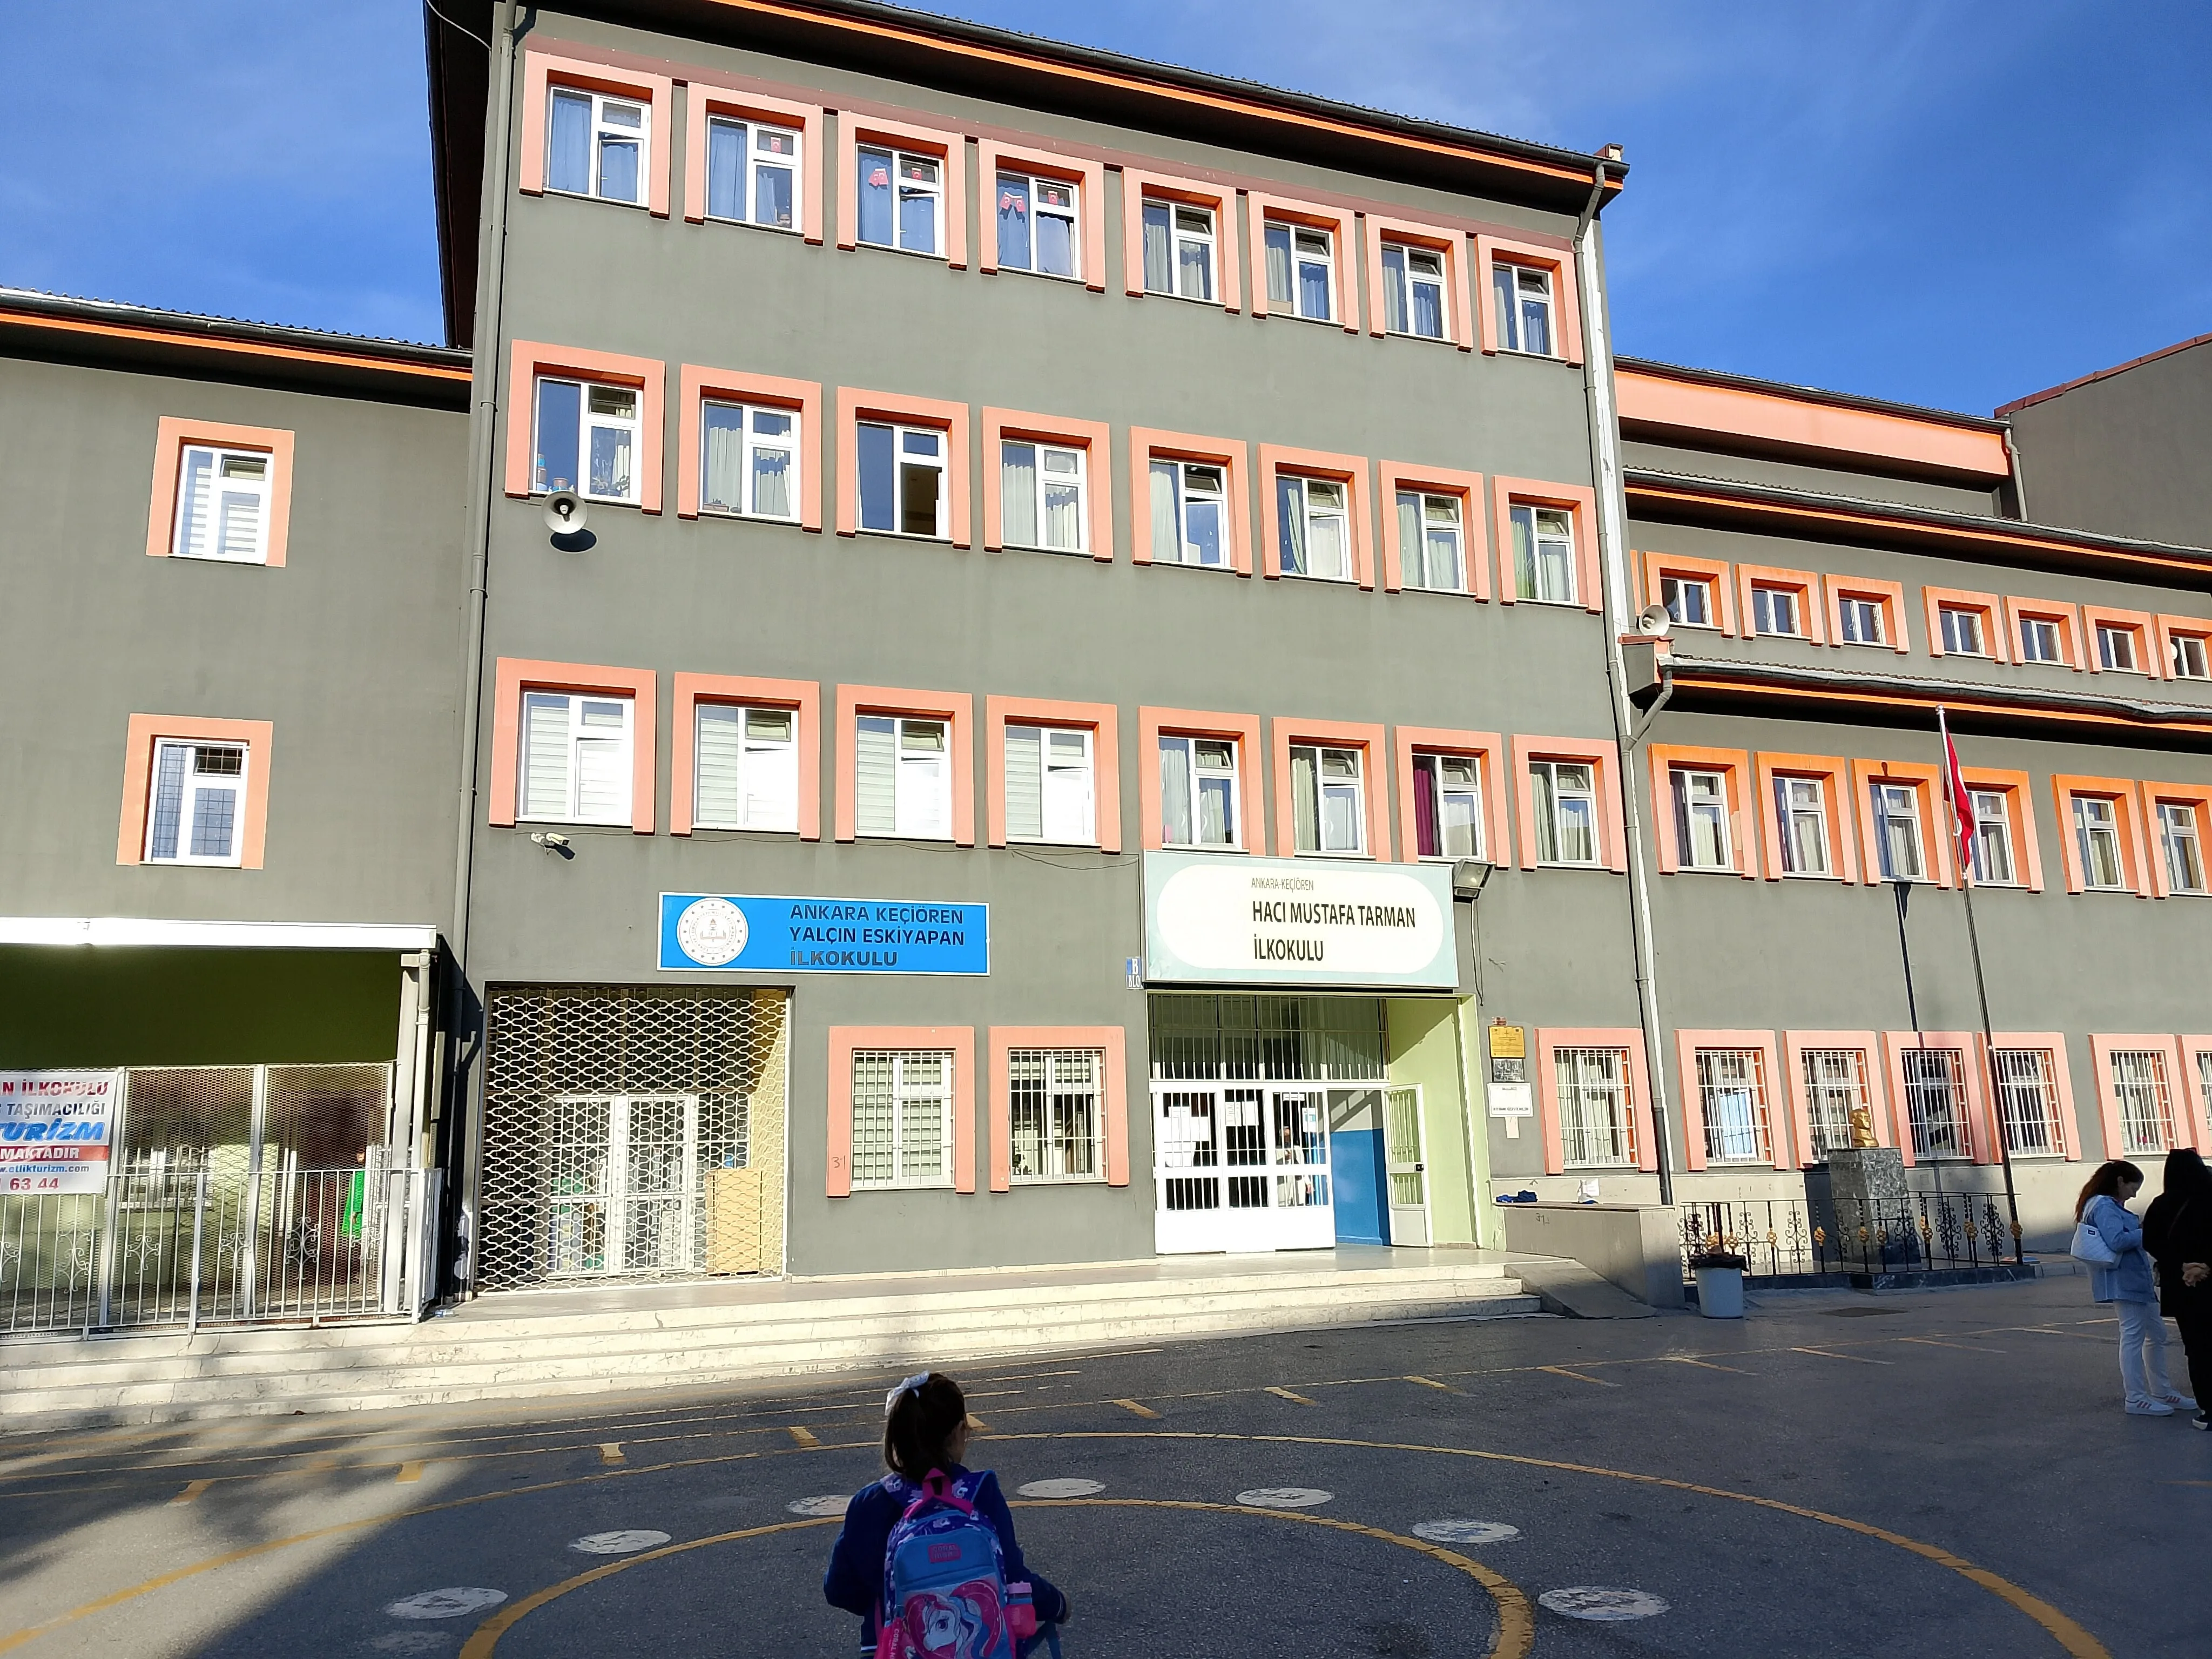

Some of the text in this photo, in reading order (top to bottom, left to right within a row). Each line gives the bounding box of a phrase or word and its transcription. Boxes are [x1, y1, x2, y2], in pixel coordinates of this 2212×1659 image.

[790, 905, 963, 925] ANKARA KEÇİÖREN
[1253, 901, 1415, 928] HACI MUSTAFA TARMAN
[790, 926, 964, 946] YALÇIN ESKİYAPAN
[790, 946, 897, 966] İLKOKULU
[1254, 933, 1323, 961] İLKOKULU
[1131, 958, 1138, 975] B
[1128, 975, 1143, 988] BLO
[0, 1078, 109, 1096] N İLKOKULU
[7, 1100, 105, 1119] TAŞIMACILIĞI
[10, 1178, 31, 1190] 63
[37, 1177, 59, 1189] 44
